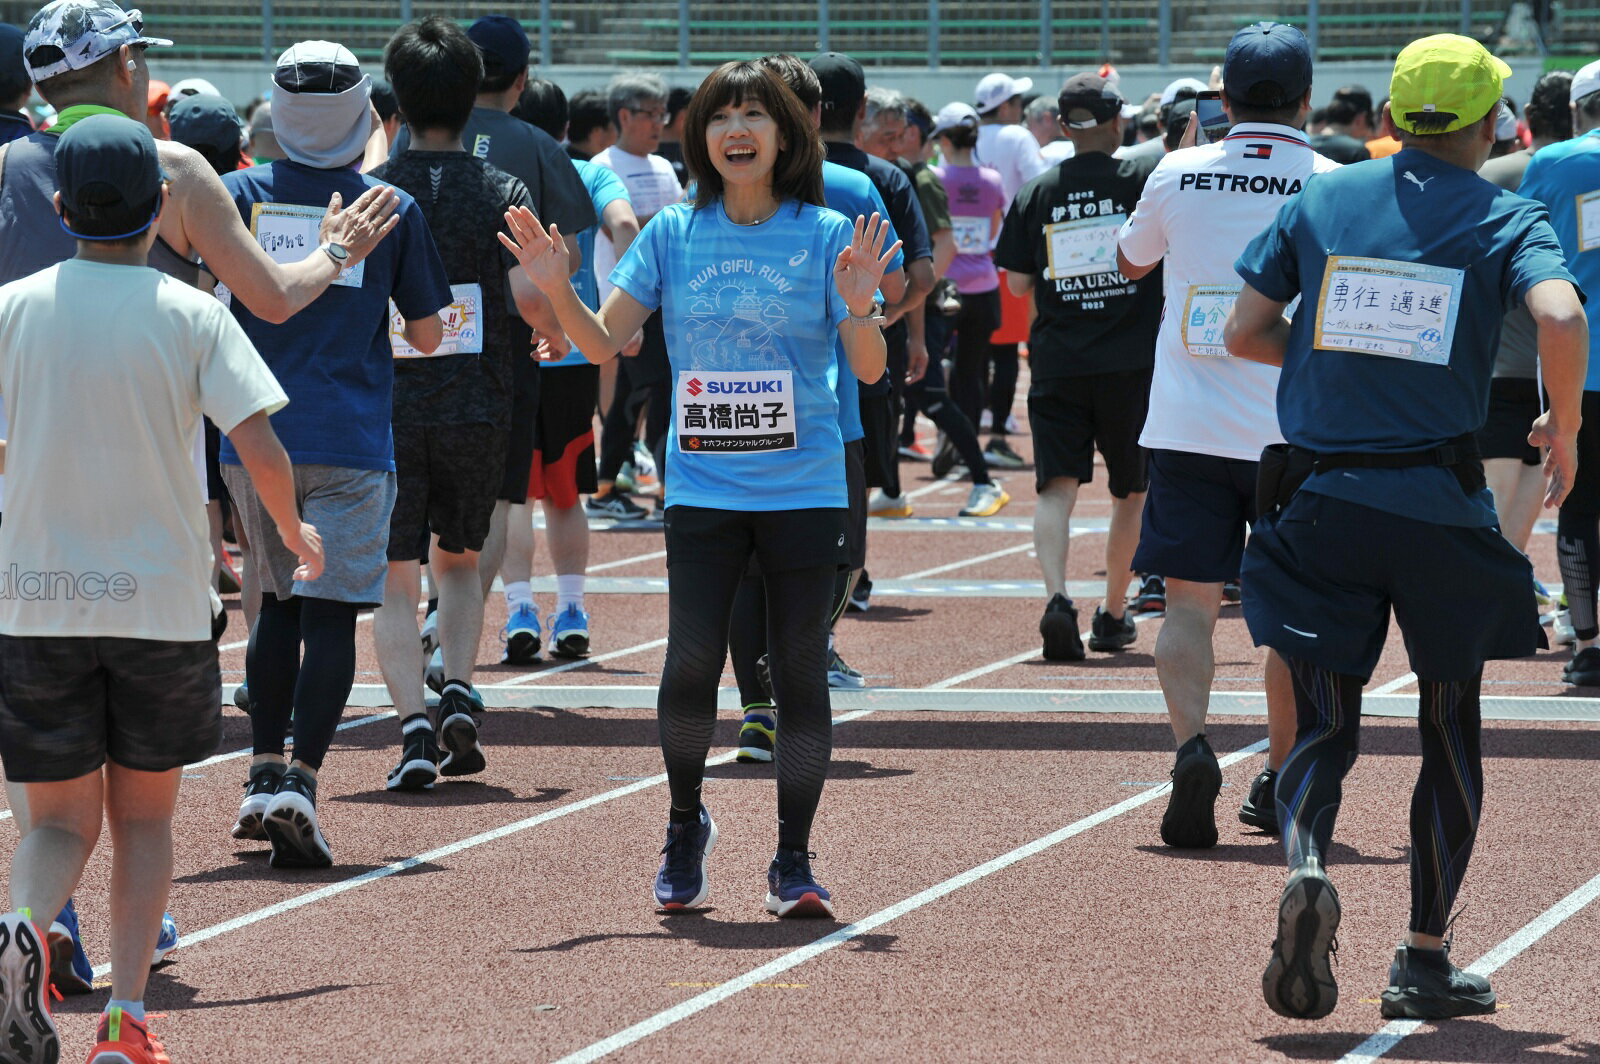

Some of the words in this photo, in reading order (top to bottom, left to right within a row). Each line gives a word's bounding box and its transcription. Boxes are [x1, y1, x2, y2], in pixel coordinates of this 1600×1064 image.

[260, 231, 304, 252] Fight
[688, 264, 718, 292] RUN
[721, 259, 755, 275] GIFU,
[758, 265, 793, 294] RUN!
[1055, 277, 1085, 292] IGA
[1062, 293, 1081, 302] CITY
[1082, 288, 1126, 300] MARATHON
[706, 380, 783, 394] SUZUKI
[683, 402, 788, 430] 高橋尚子
[702, 436, 784, 447] 十六フィナンシャルグループ
